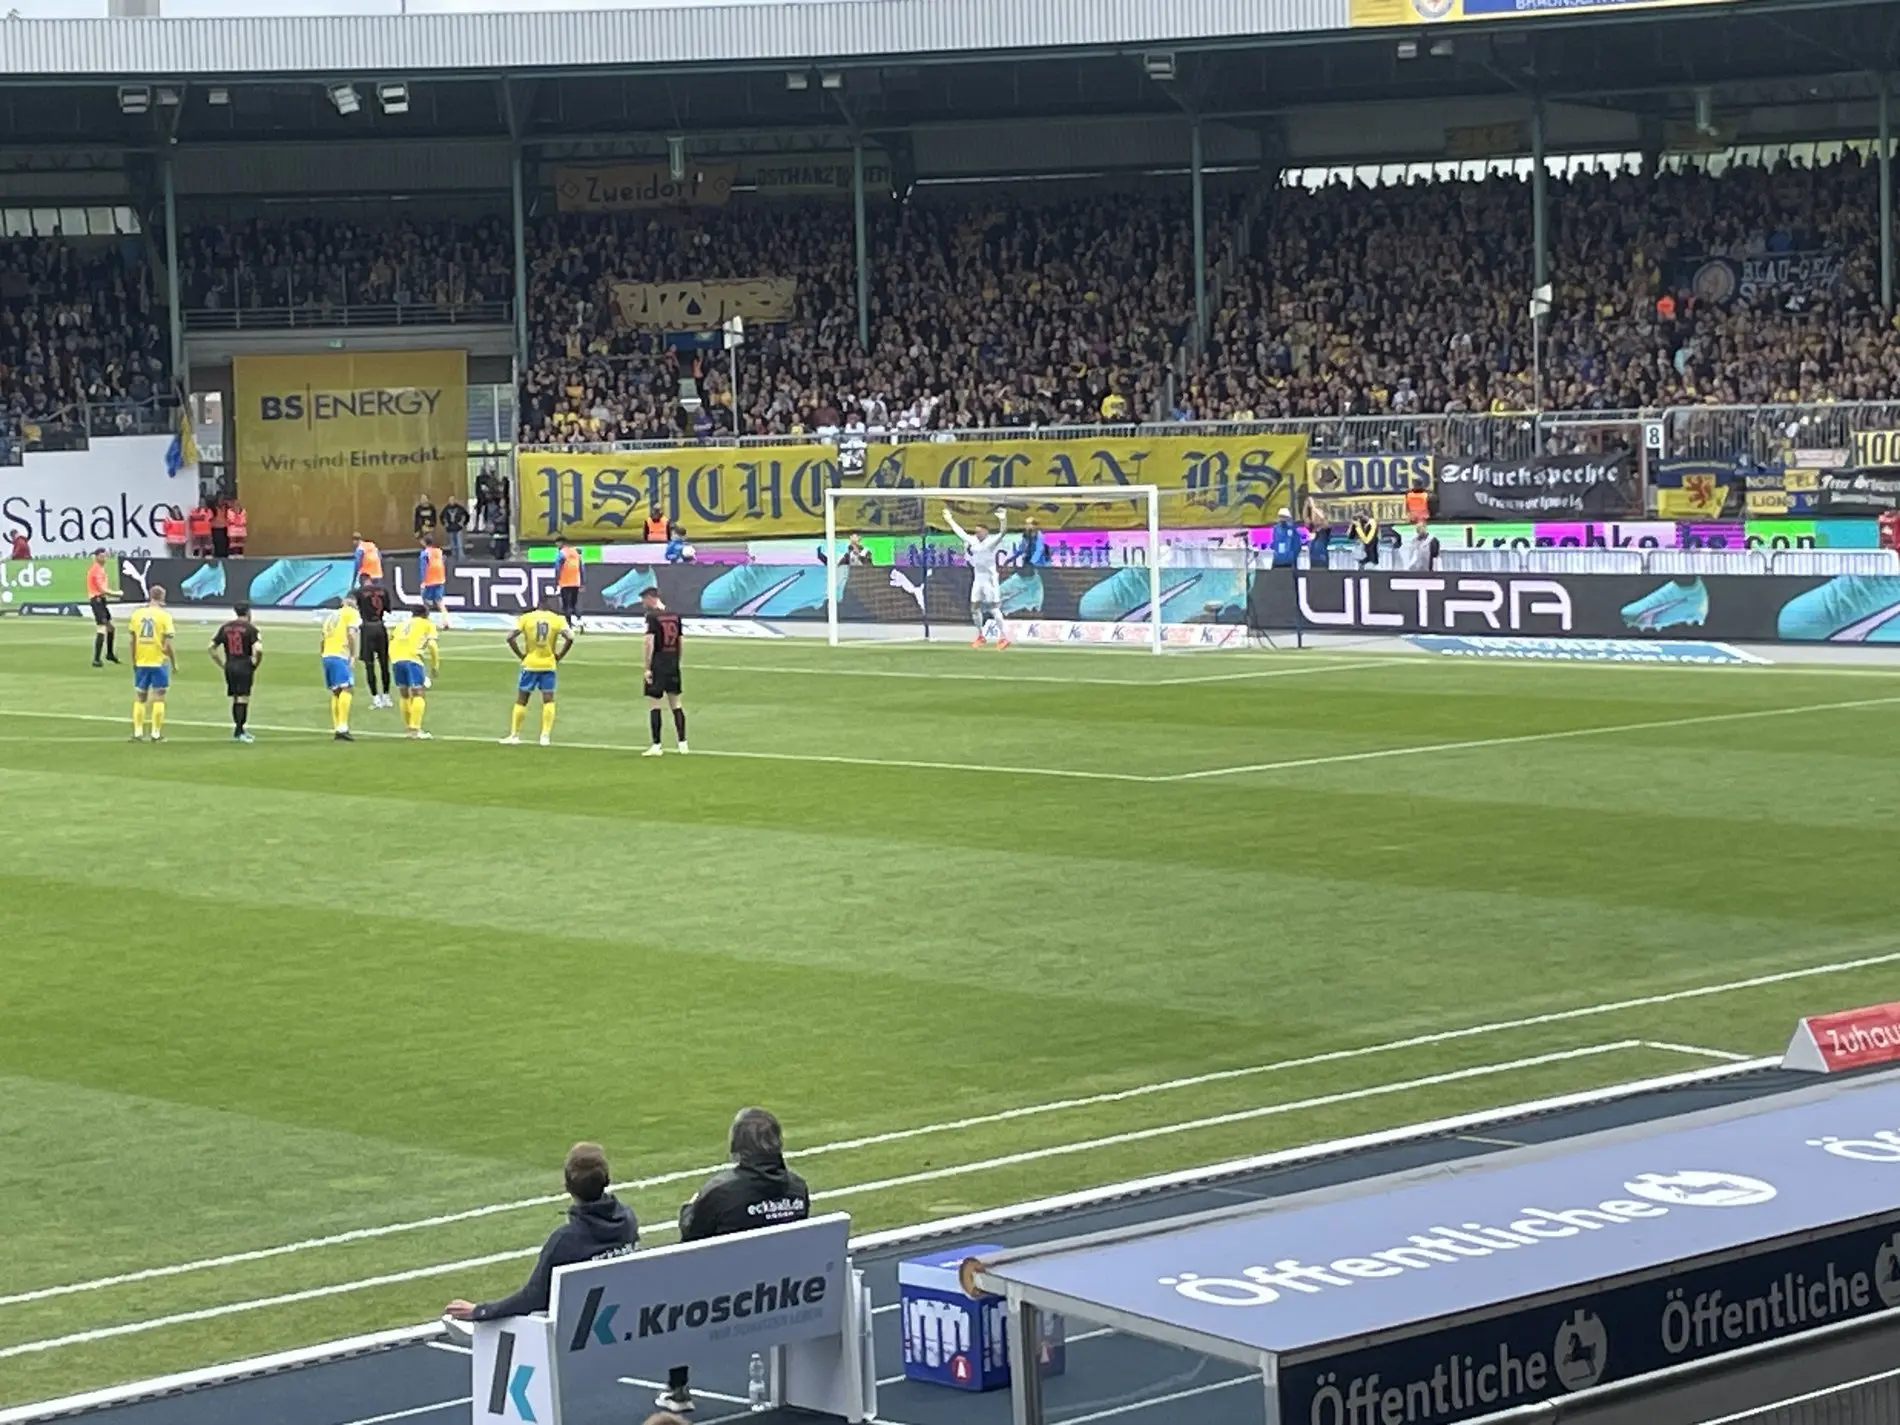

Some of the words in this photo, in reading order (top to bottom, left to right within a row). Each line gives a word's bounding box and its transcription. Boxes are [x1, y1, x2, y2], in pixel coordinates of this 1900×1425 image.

[260, 455, 296, 470] Wir
[303, 451, 343, 469] sind
[350, 447, 446, 467] Eintracht.
[1649, 427, 1660, 446] 8
[1344, 457, 1431, 493] DOGS
[2, 492, 169, 543] Staake
[1299, 577, 1573, 630] ULTRA
[1827, 1024, 1900, 1056] Zuhau
[1157, 1199, 1670, 1306] Öffentliche
[1661, 1262, 1870, 1354] Öffentliche
[1310, 1343, 1548, 1425] Öffentliche
